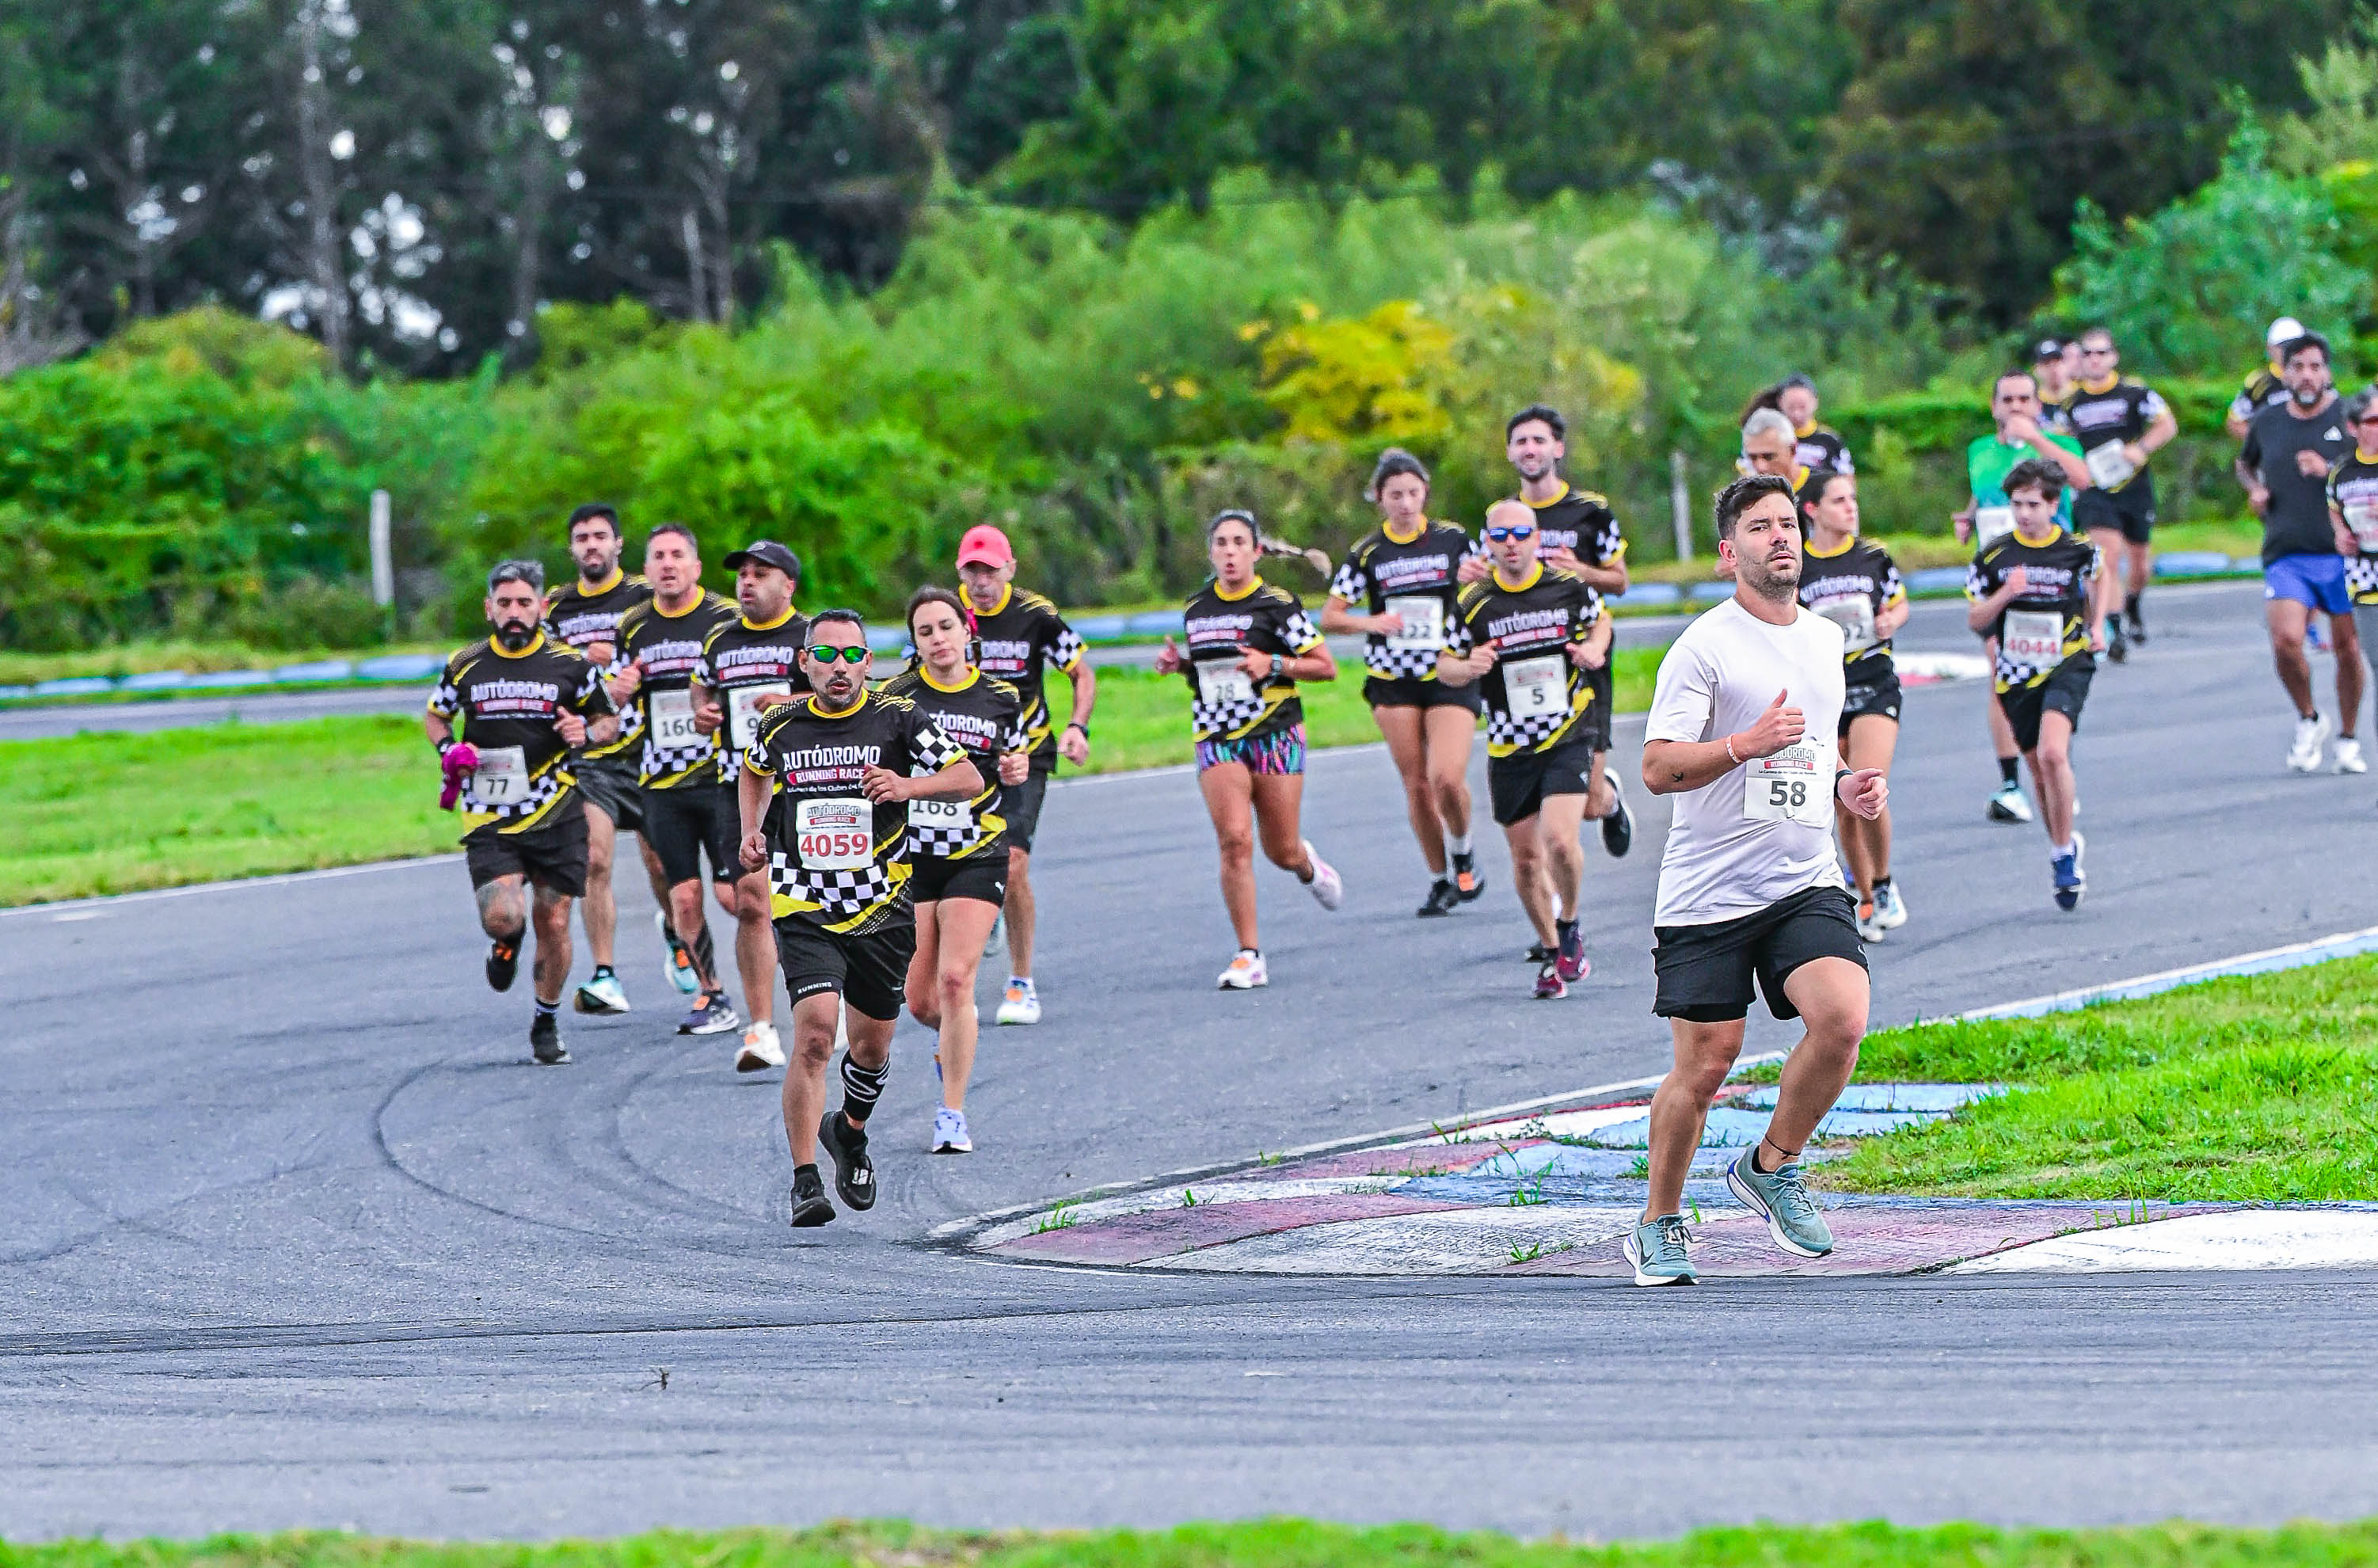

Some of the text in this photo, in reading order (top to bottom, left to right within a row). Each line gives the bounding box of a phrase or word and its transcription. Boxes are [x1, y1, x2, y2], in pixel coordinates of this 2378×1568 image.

[1531, 687, 1545, 705] 5
[782, 744, 881, 772] AUTÓDROMO
[795, 768, 865, 784] RUNNING RACE
[485, 778, 508, 796] 77
[1769, 780, 1806, 807] 58
[801, 833, 868, 858] 4059
